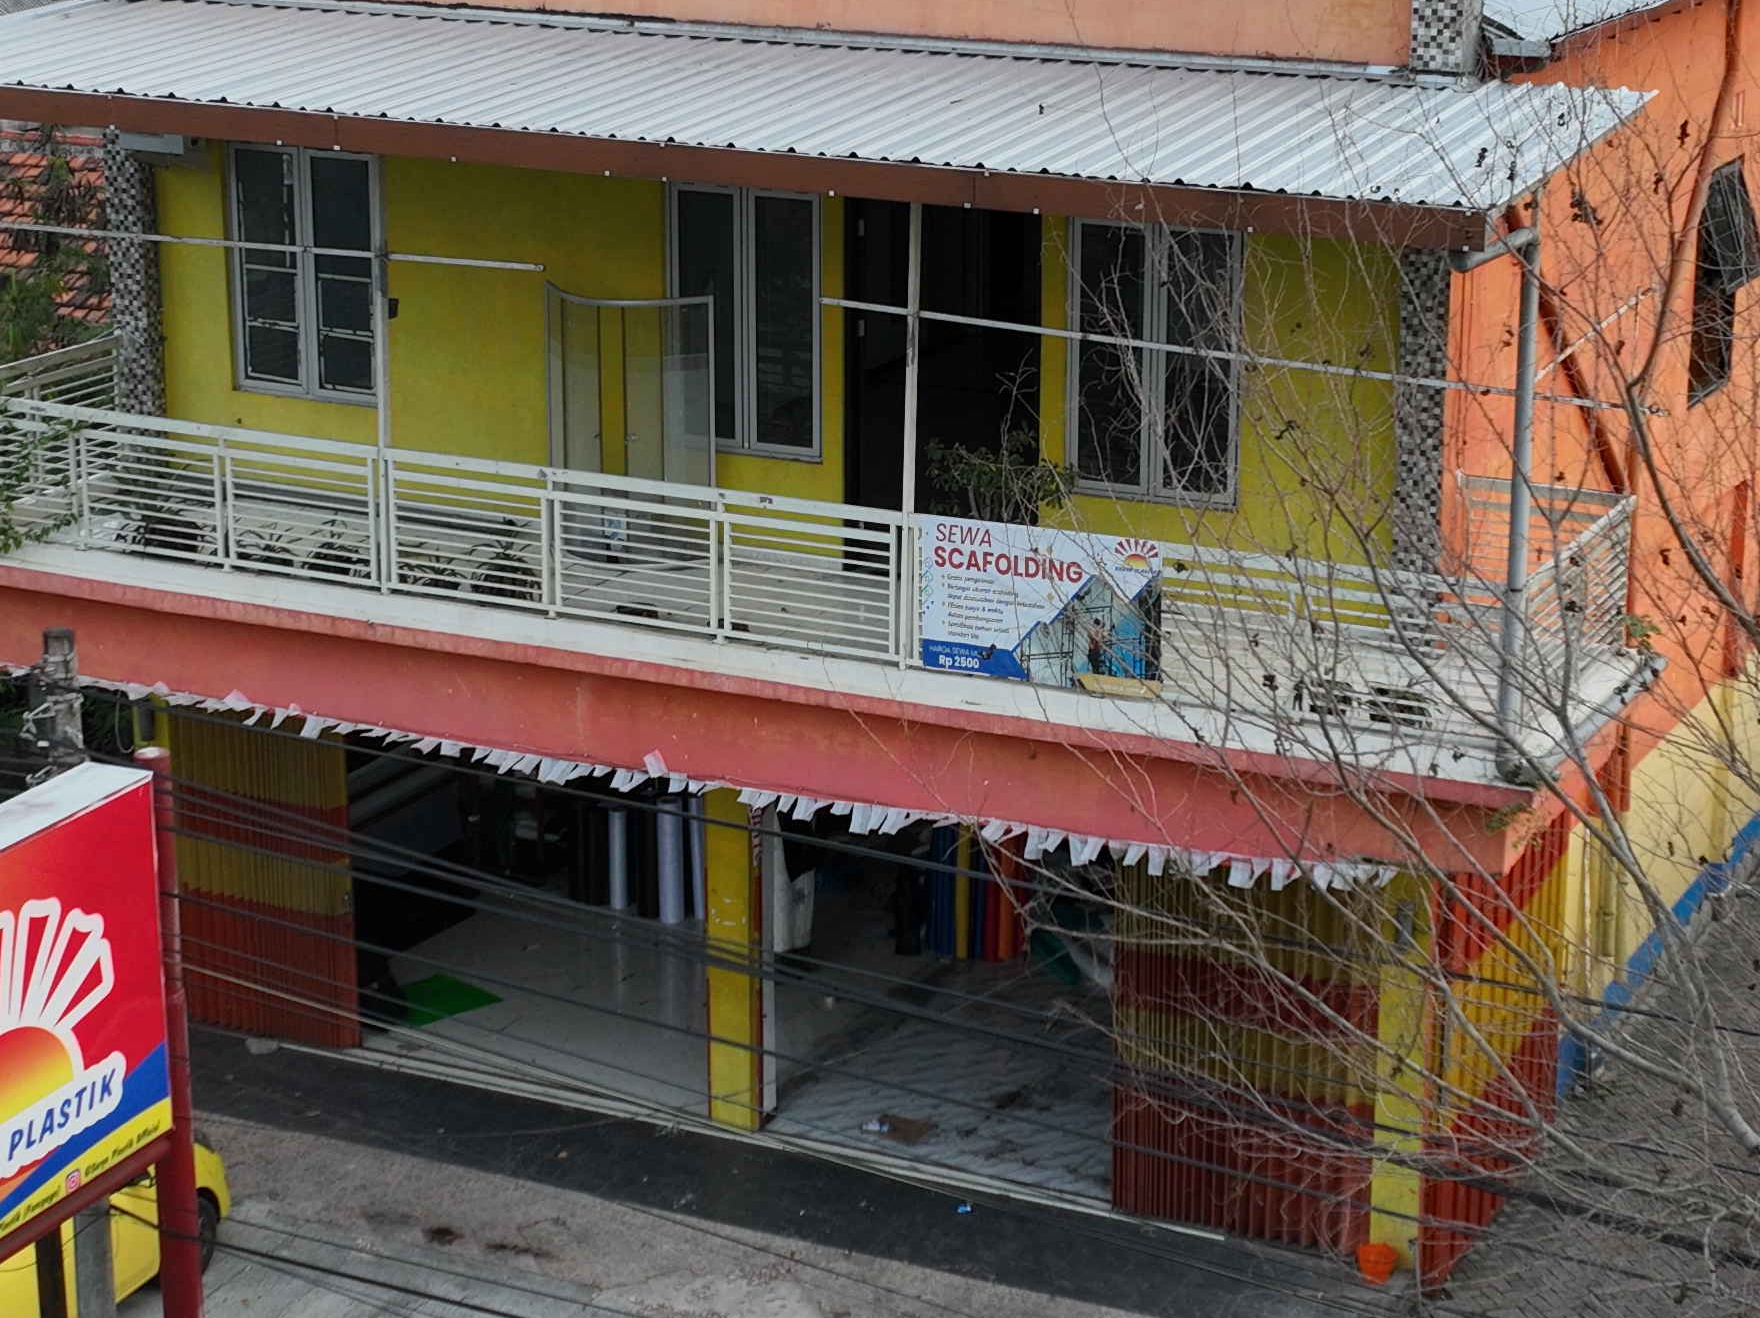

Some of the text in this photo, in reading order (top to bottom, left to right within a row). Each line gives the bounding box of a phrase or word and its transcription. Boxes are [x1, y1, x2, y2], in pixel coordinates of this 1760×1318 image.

[935, 522, 992, 548] SEWA
[934, 545, 1083, 584] SCAFOLDING
[938, 655, 953, 669] Rp
[954, 655, 980, 669] 2500
[952, 647, 970, 656] SEWA
[7, 1068, 116, 1162] PLASTIK
